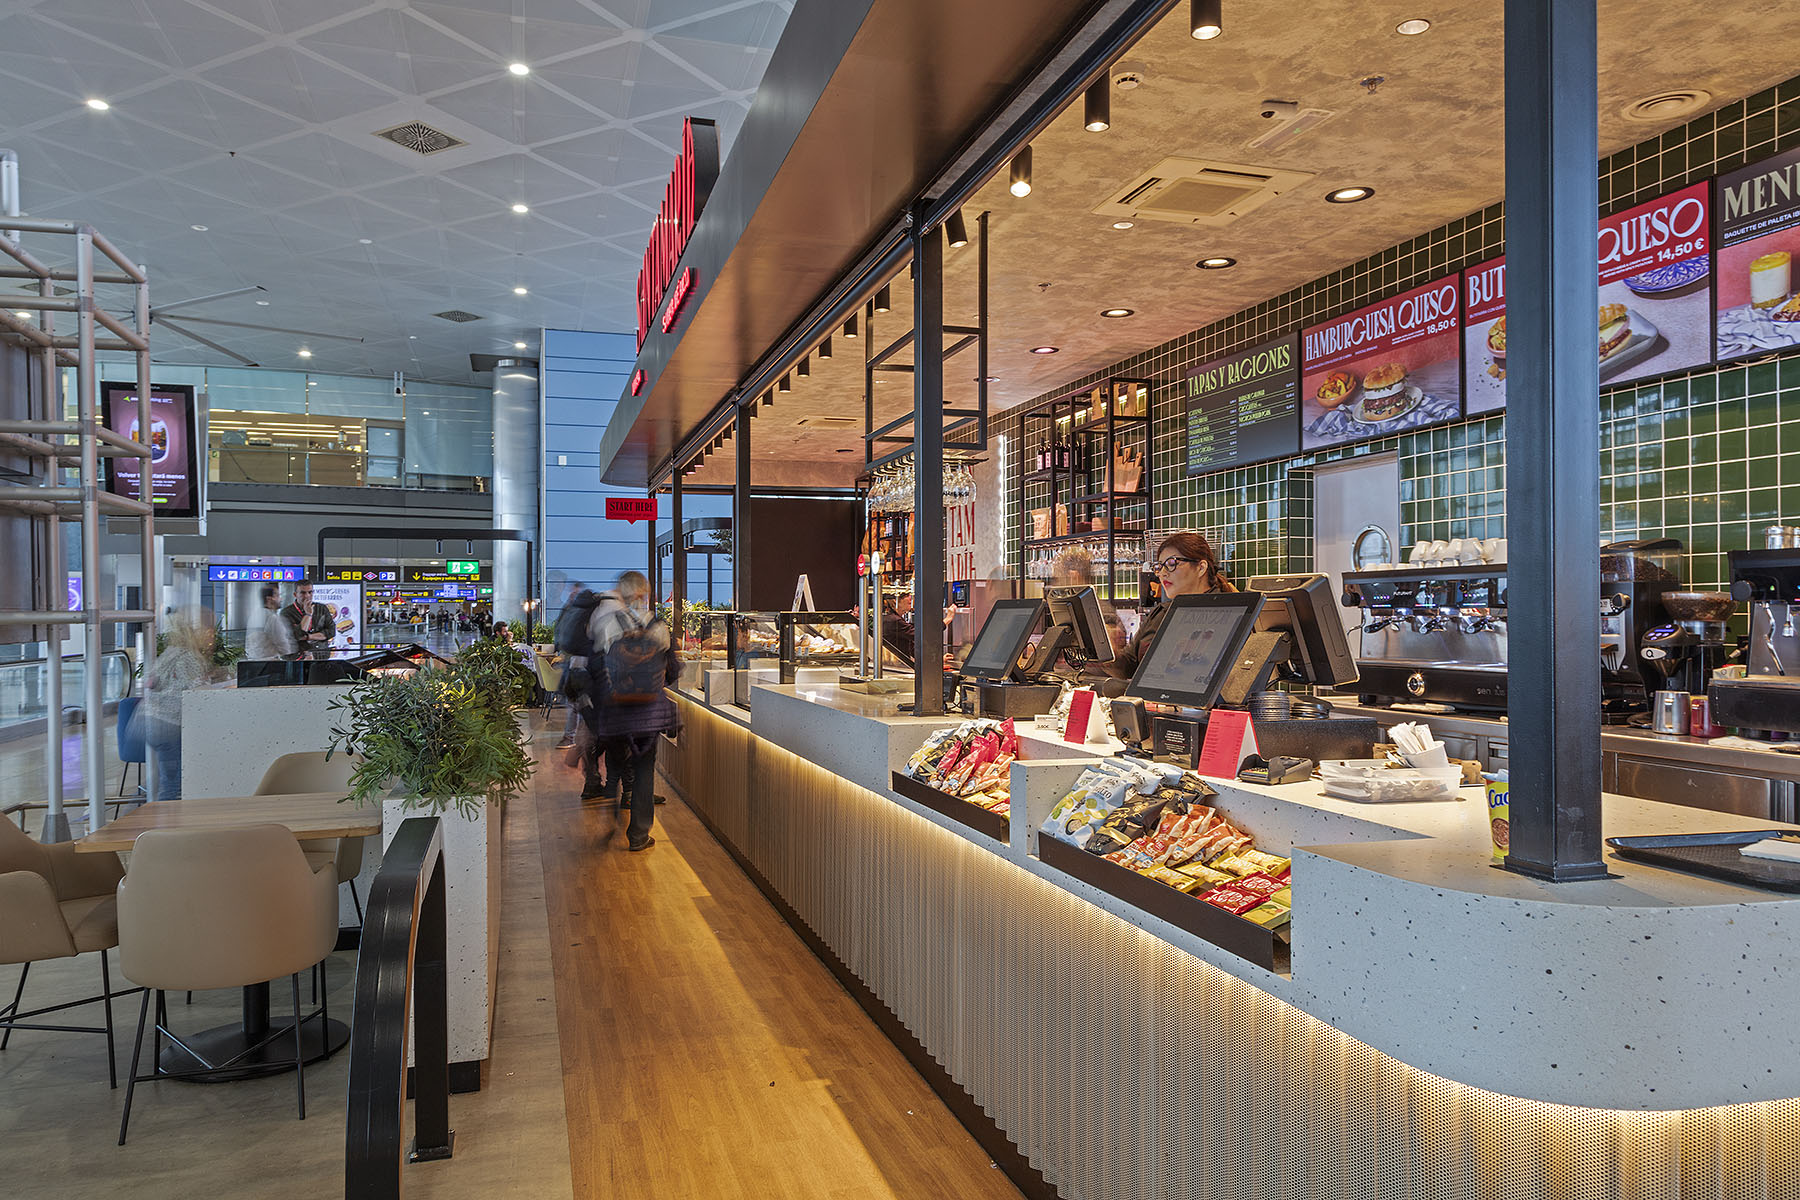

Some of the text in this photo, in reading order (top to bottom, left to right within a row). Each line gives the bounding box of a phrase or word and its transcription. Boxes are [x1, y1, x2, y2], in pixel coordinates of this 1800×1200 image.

[1724, 223, 1757, 239] BAGUETTE
[1758, 220, 1767, 229] DE
[1657, 238, 1704, 262] 14,50 €
[1305, 284, 1457, 362] HAMBURGUESA QUESO
[1426, 317, 1457, 335] 18,50 €
[1188, 369, 1217, 397] TAPAS
[1219, 366, 1226, 388] Y
[1228, 344, 1291, 385] RACIONES
[610, 502, 654, 512] START HERE
